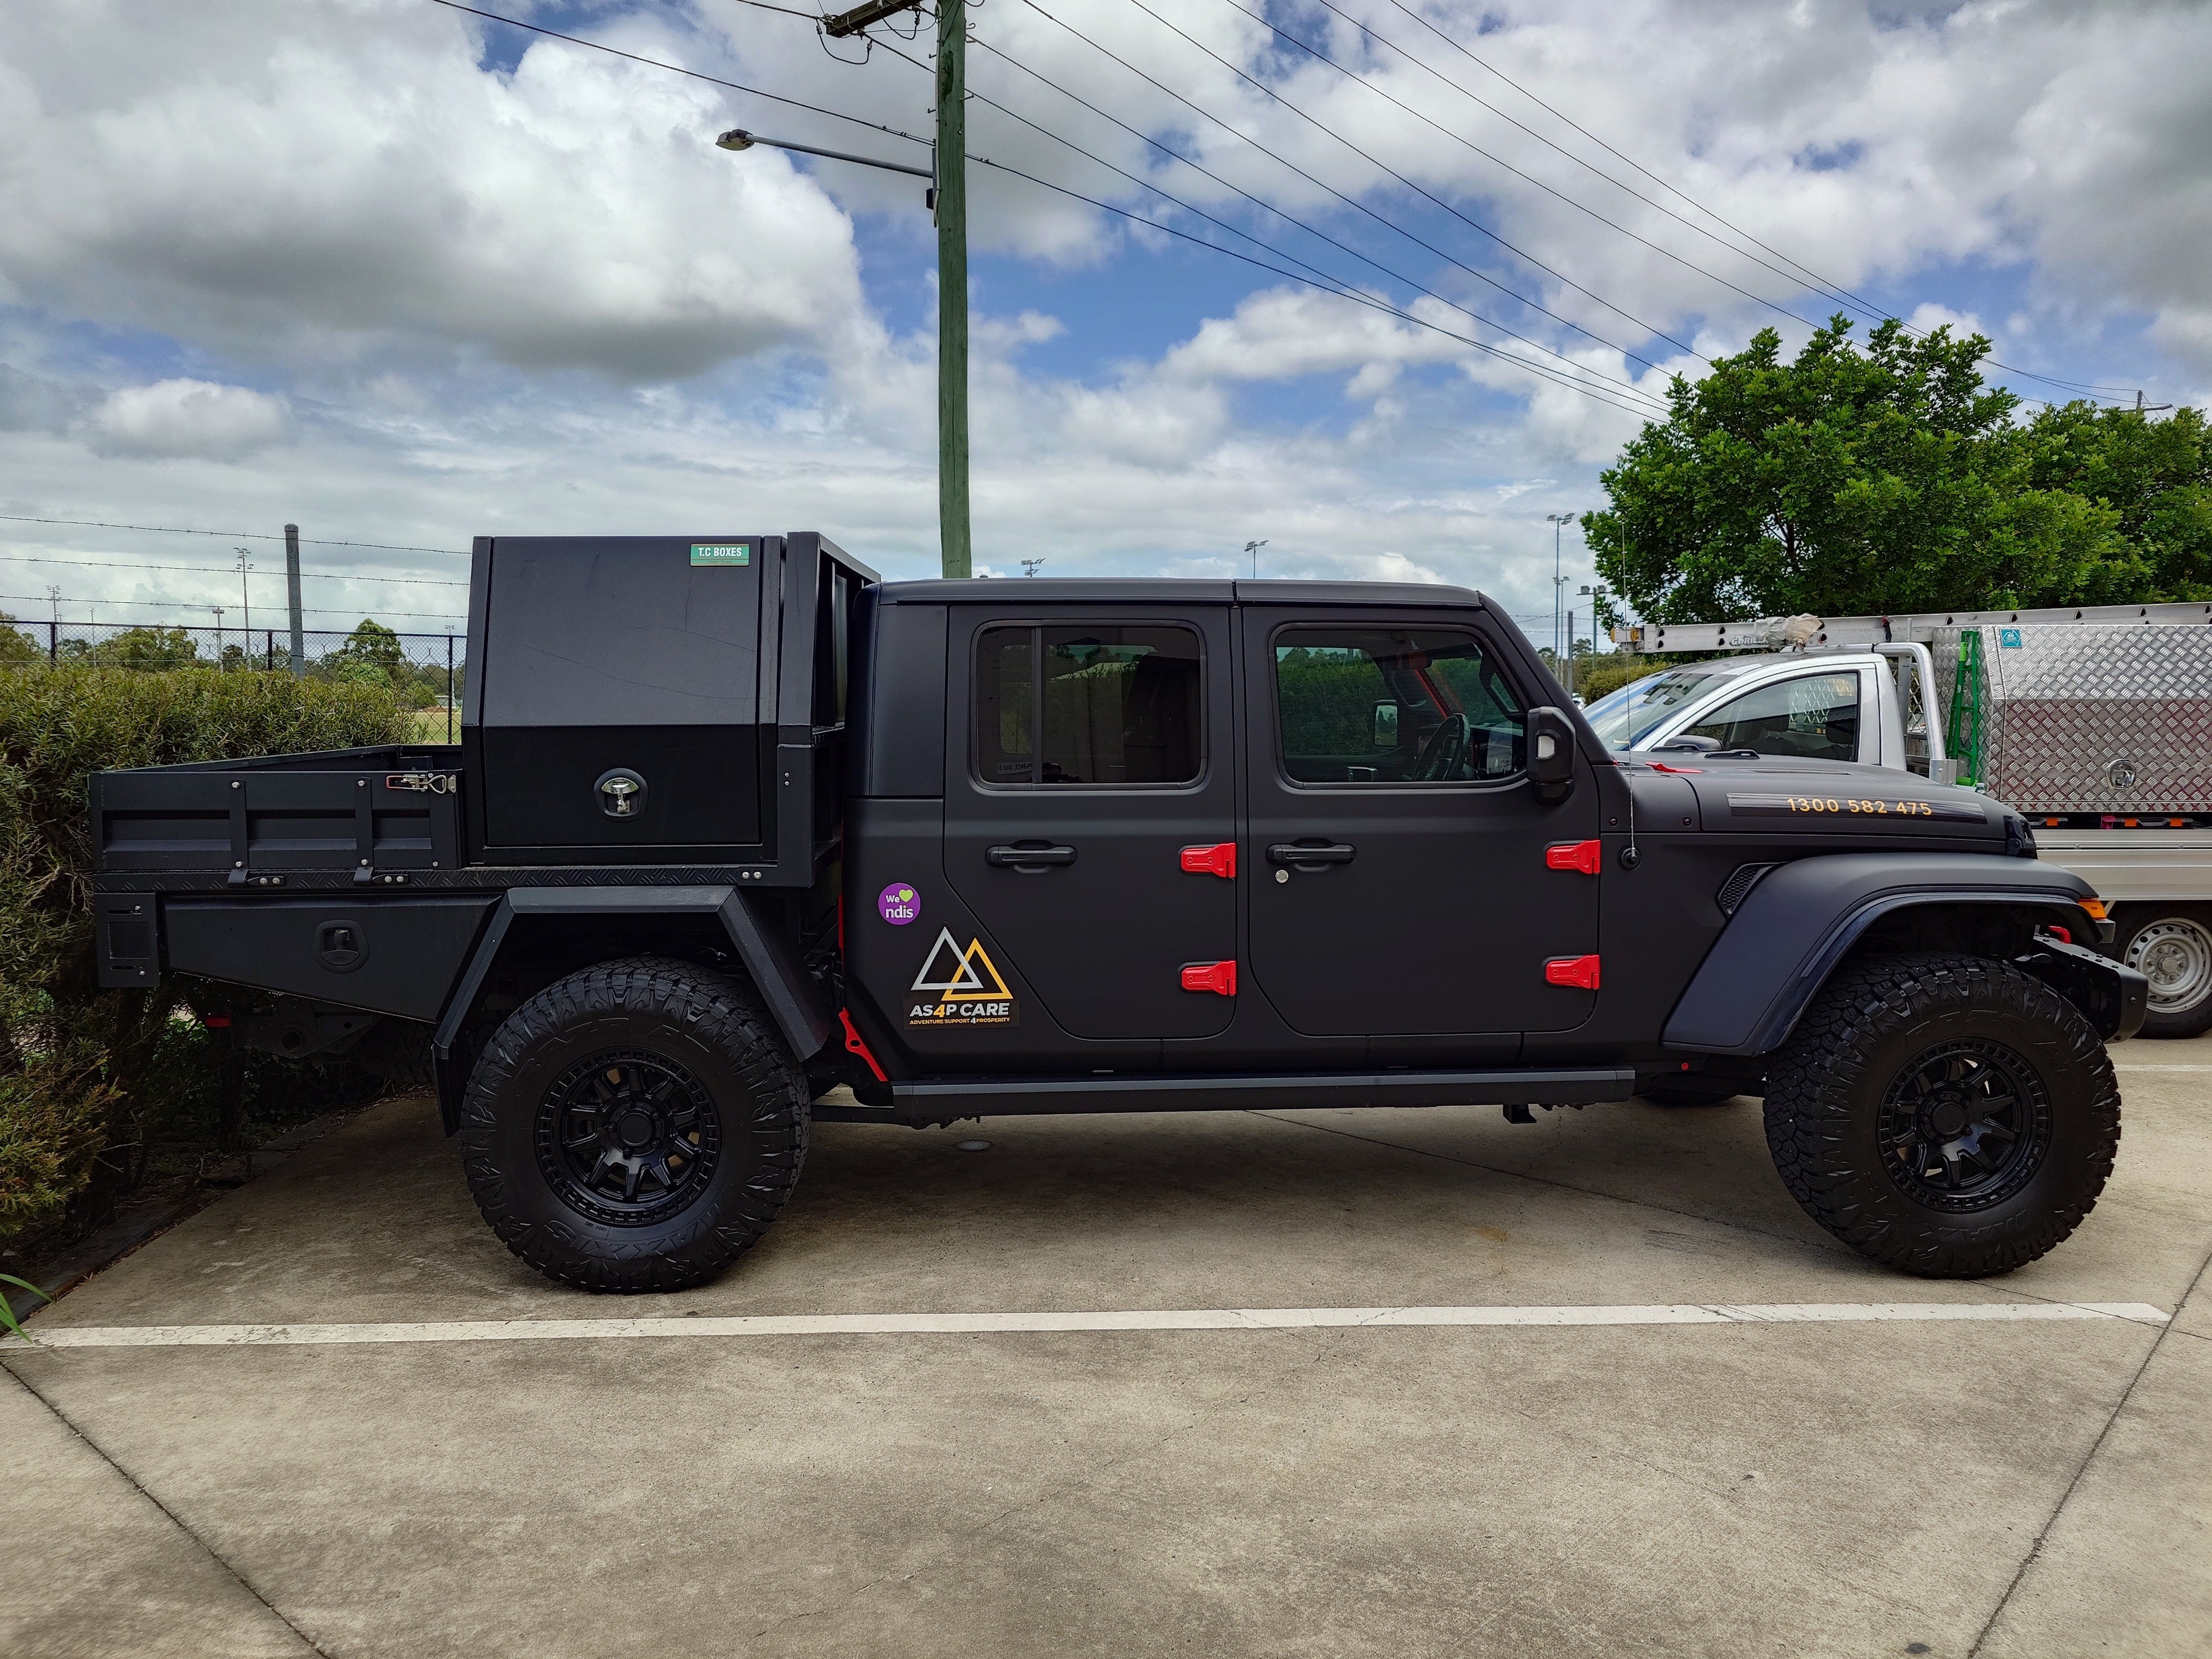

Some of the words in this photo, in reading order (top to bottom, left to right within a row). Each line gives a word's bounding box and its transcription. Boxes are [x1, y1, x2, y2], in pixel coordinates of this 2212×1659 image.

[698, 547, 711, 557] T.C
[713, 547, 742, 557] BOXES
[1787, 798, 1839, 813] 1300
[1847, 800, 1888, 814] 582
[1896, 801, 1932, 816] 475
[885, 895, 900, 903] We
[885, 905, 914, 919] ndis
[909, 1004, 957, 1018] AS4P
[959, 1003, 1010, 1016] CARE
